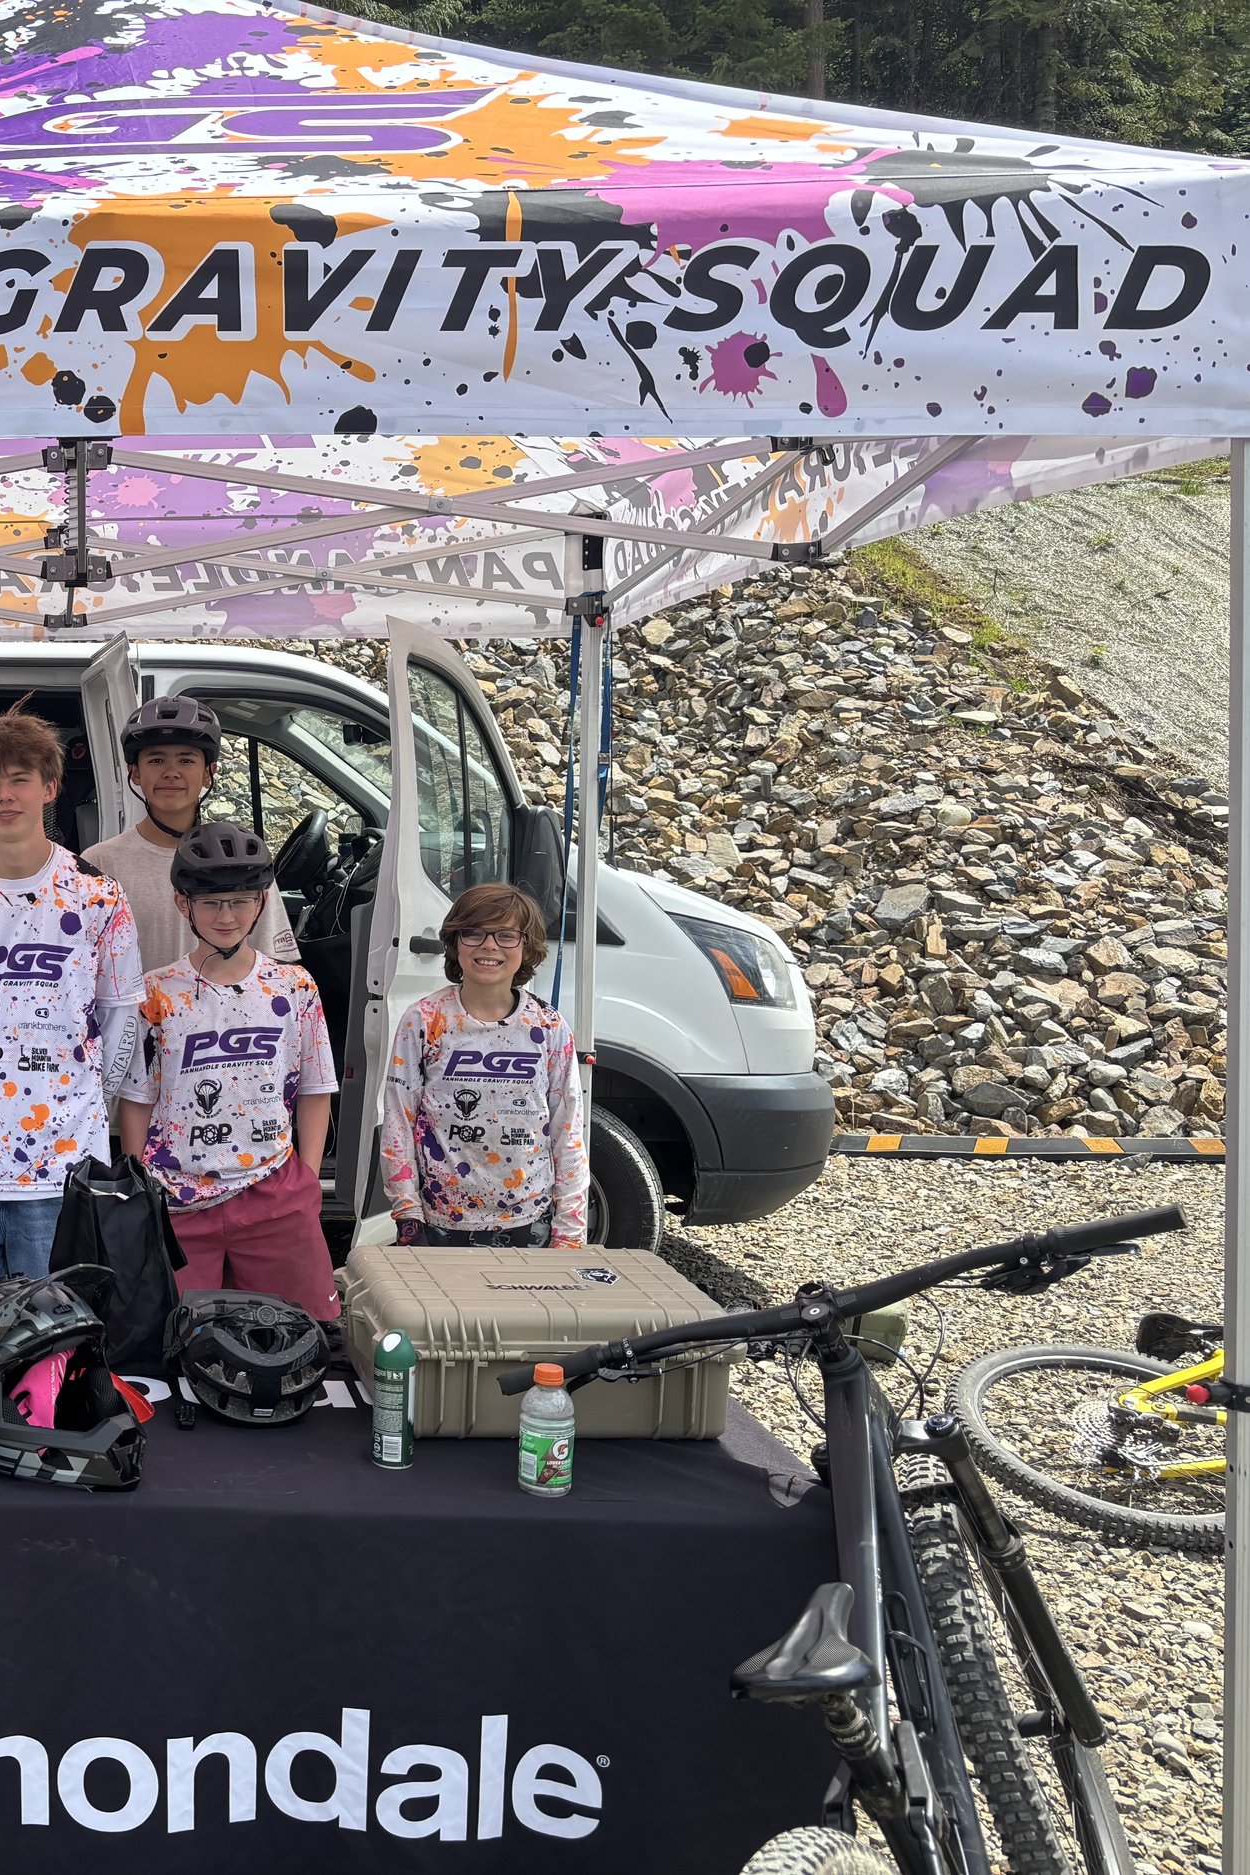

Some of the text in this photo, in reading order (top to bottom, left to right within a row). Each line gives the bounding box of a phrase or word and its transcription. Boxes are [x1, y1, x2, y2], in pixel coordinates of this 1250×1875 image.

[664, 243, 1212, 349] SQUAD
[35, 980, 59, 988] SQUAD
[181, 1027, 284, 1069] PGS
[31, 1062, 46, 1072] BIKE
[444, 1050, 542, 1079] PGS
[510, 1138, 523, 1146] BIKE
